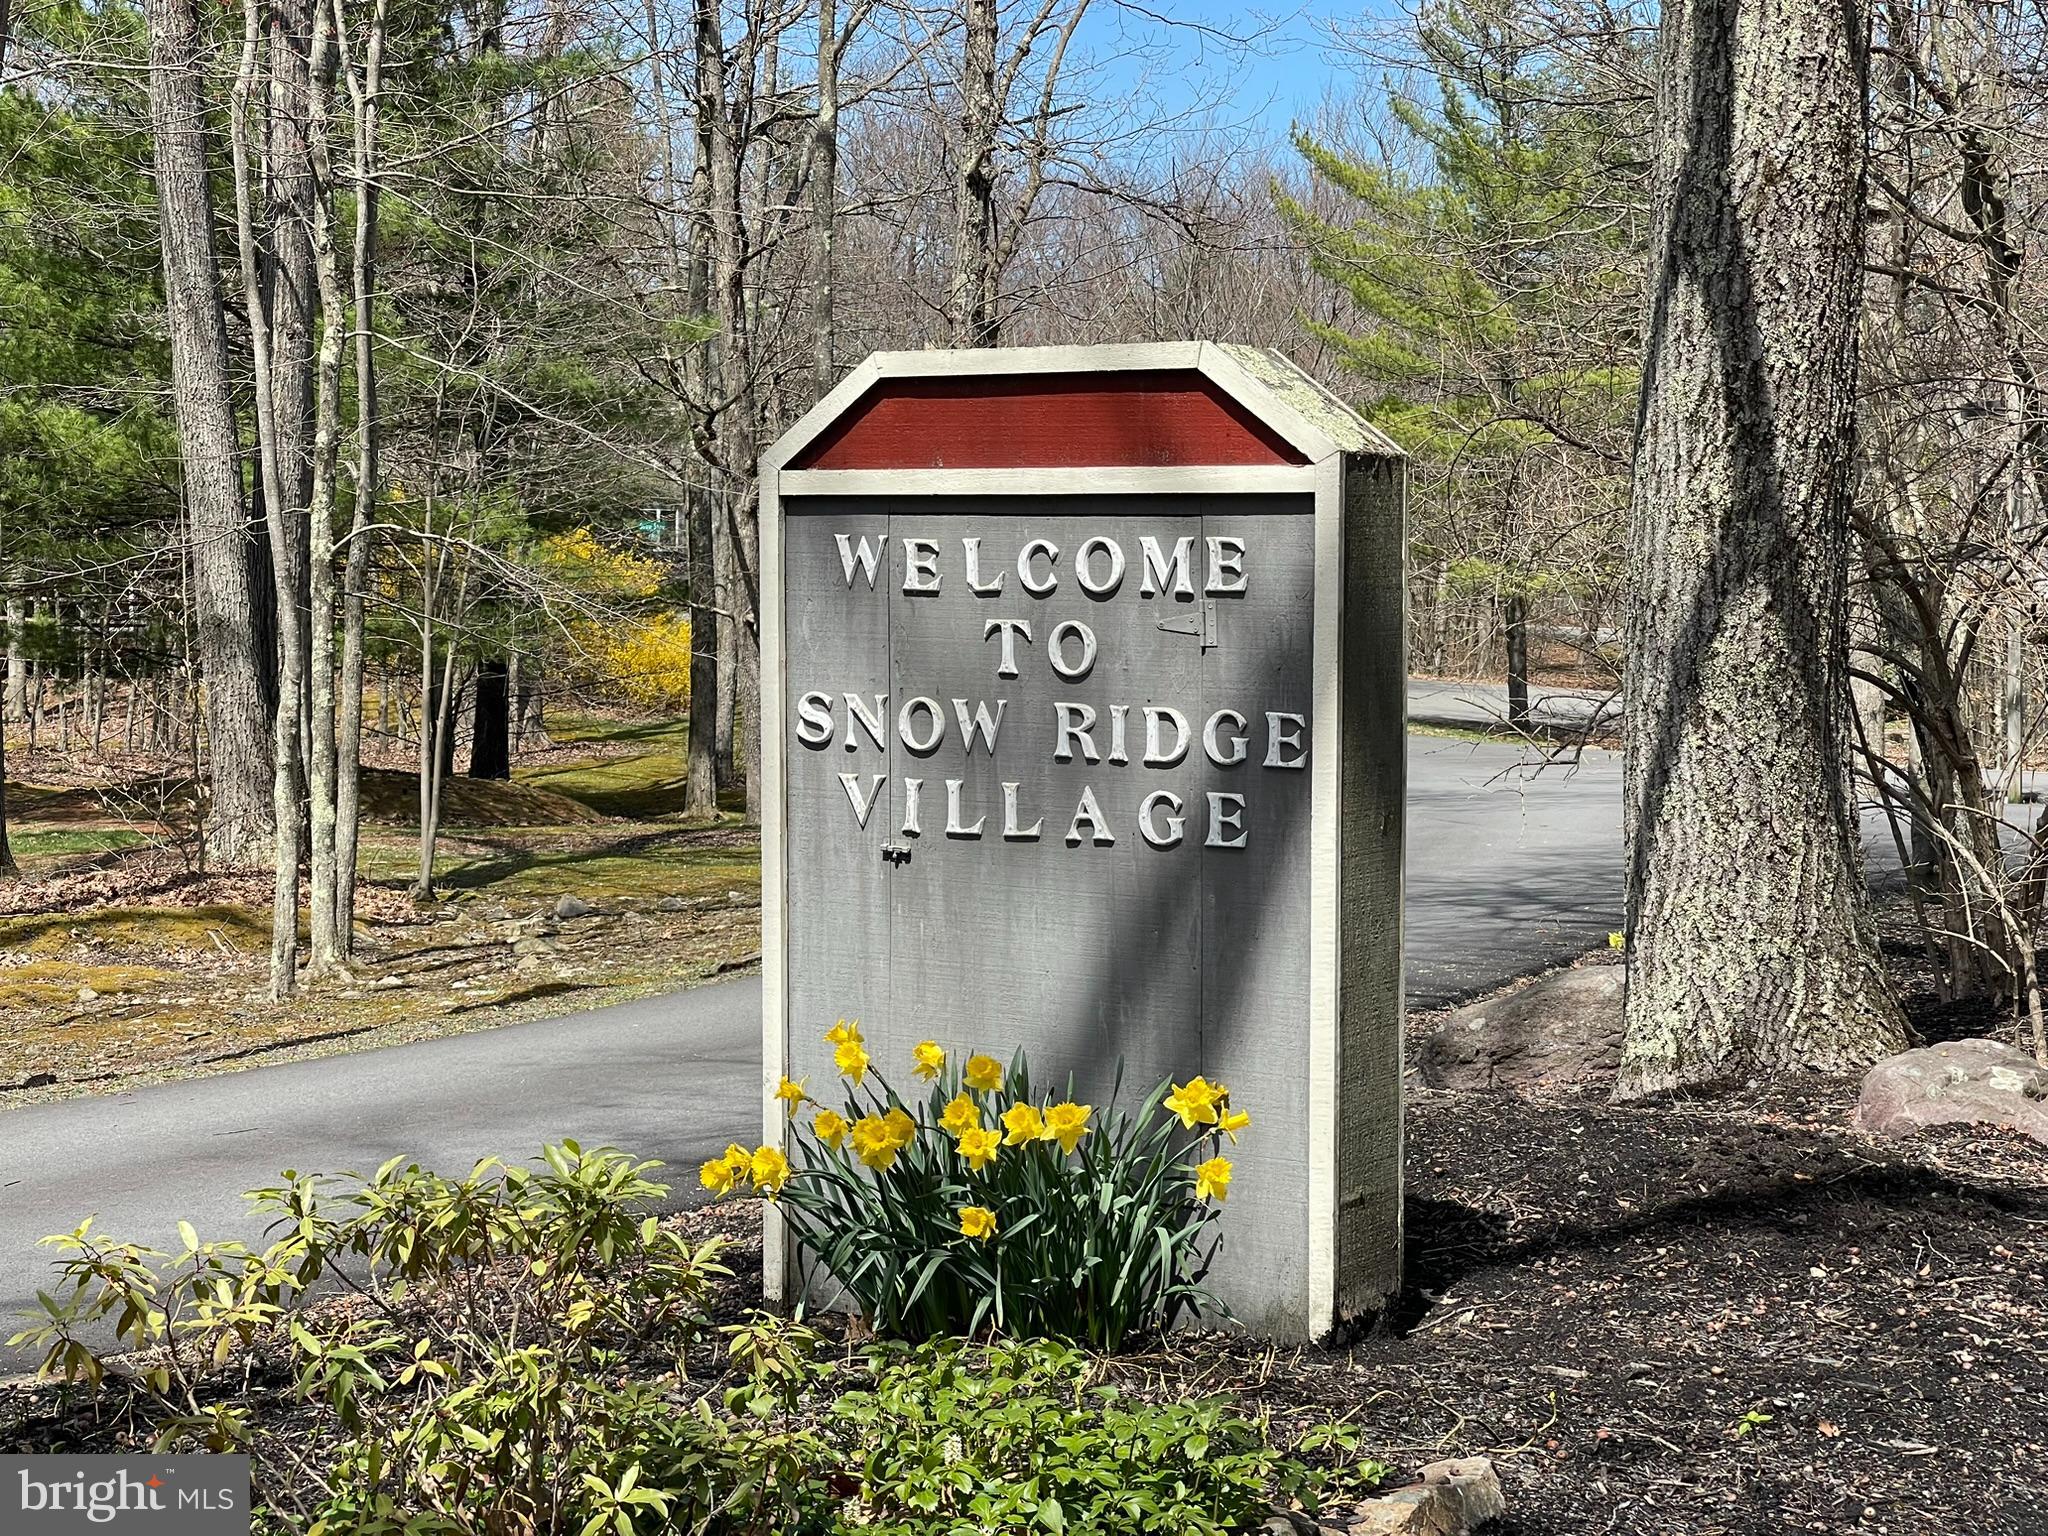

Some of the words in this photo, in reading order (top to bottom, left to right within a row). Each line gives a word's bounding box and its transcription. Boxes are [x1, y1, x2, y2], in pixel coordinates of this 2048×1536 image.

[833, 533, 1250, 596] WELCOME
[983, 618, 1097, 681] TO
[795, 690, 1008, 755] SNOW
[1053, 701, 1308, 768] RIDGE
[837, 772, 1250, 849] VILLAGE
